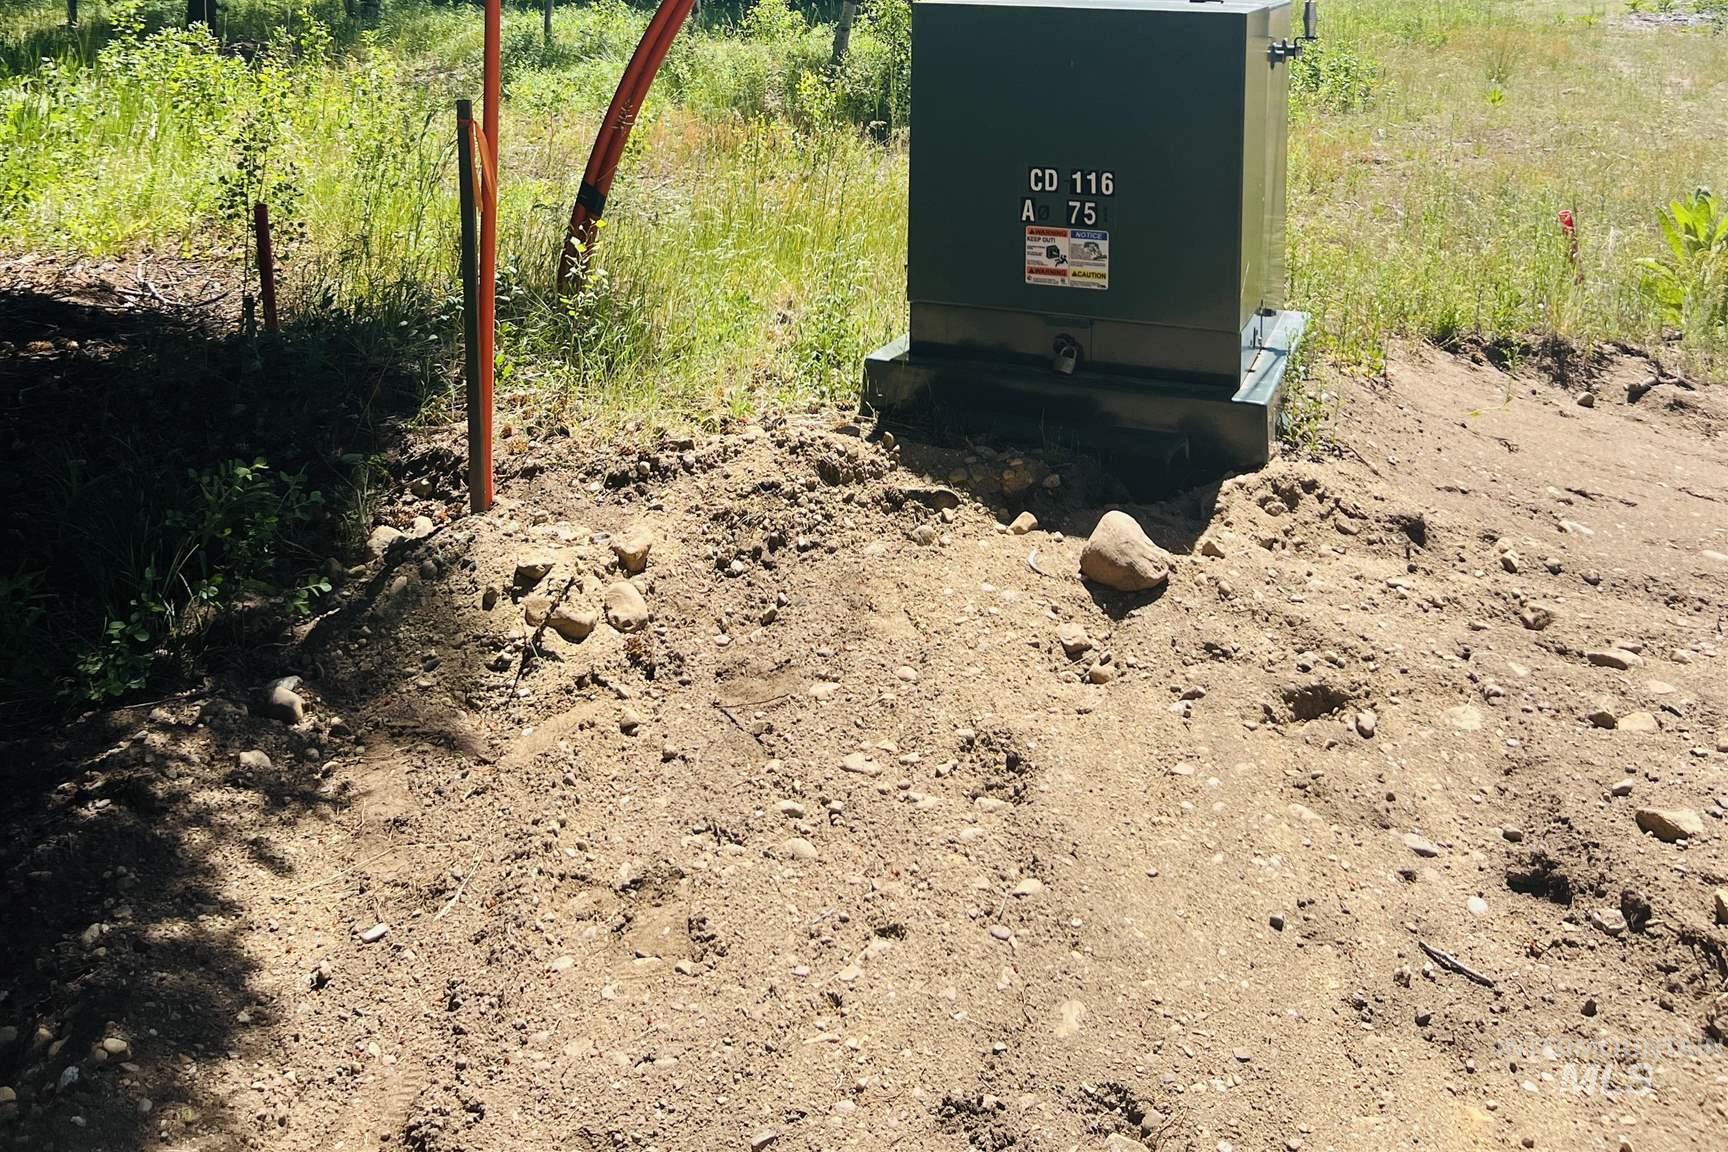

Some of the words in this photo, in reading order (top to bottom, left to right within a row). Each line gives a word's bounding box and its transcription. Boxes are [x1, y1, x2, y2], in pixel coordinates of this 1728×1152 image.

[1030, 168, 1058, 192] CD
[1072, 171, 1114, 195] 116
[1021, 199, 1035, 222] A
[1068, 201, 1097, 225] 75
[1075, 231, 1103, 240] NOTICE
[1076, 271, 1107, 280] CAUTION
